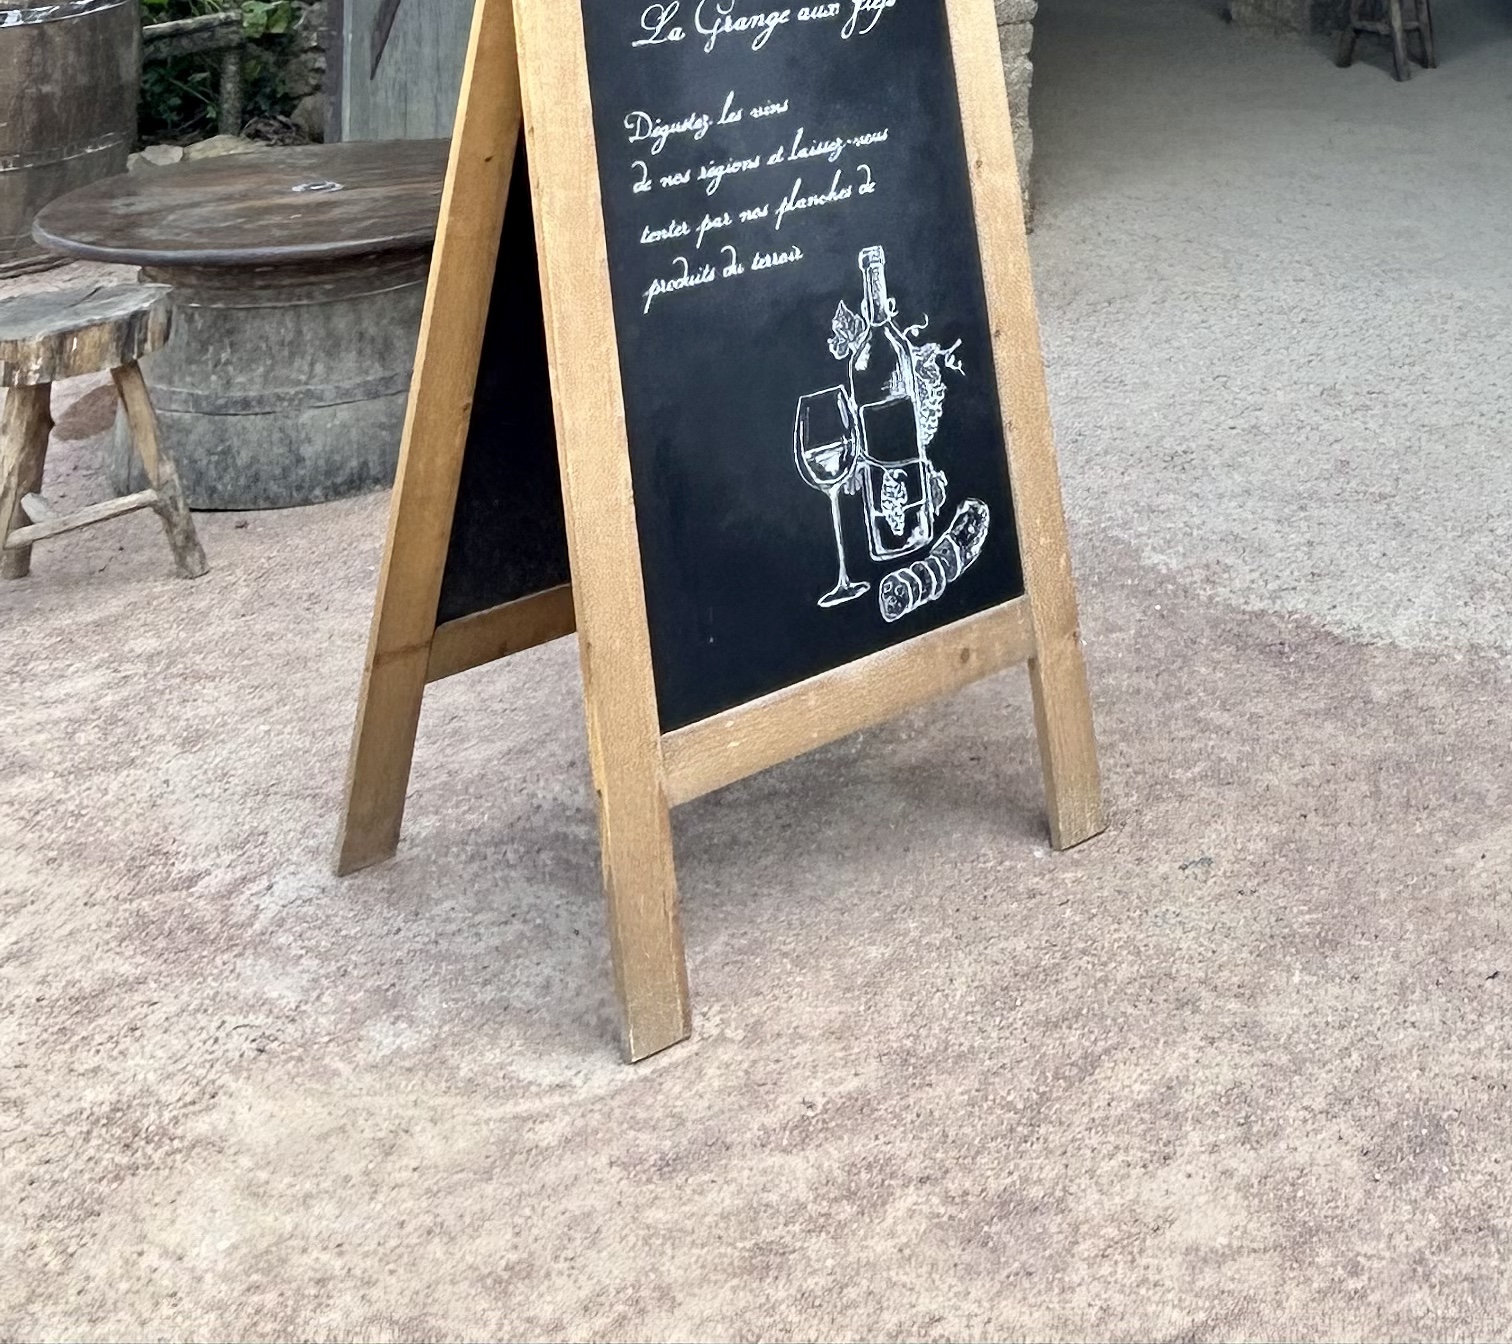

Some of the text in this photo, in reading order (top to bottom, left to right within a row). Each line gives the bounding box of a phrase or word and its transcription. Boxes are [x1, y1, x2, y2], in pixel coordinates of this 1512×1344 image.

[631, 0, 686, 48] La
[797, 2, 841, 21] aux
[623, 90, 790, 156] Dégustez les vins
[631, 160, 652, 194] de
[660, 169, 691, 188] nos
[697, 155, 761, 196] régions
[766, 145, 785, 165] et
[640, 164, 877, 249] tenter par nos planches de
[642, 245, 804, 315] produits du terroir
